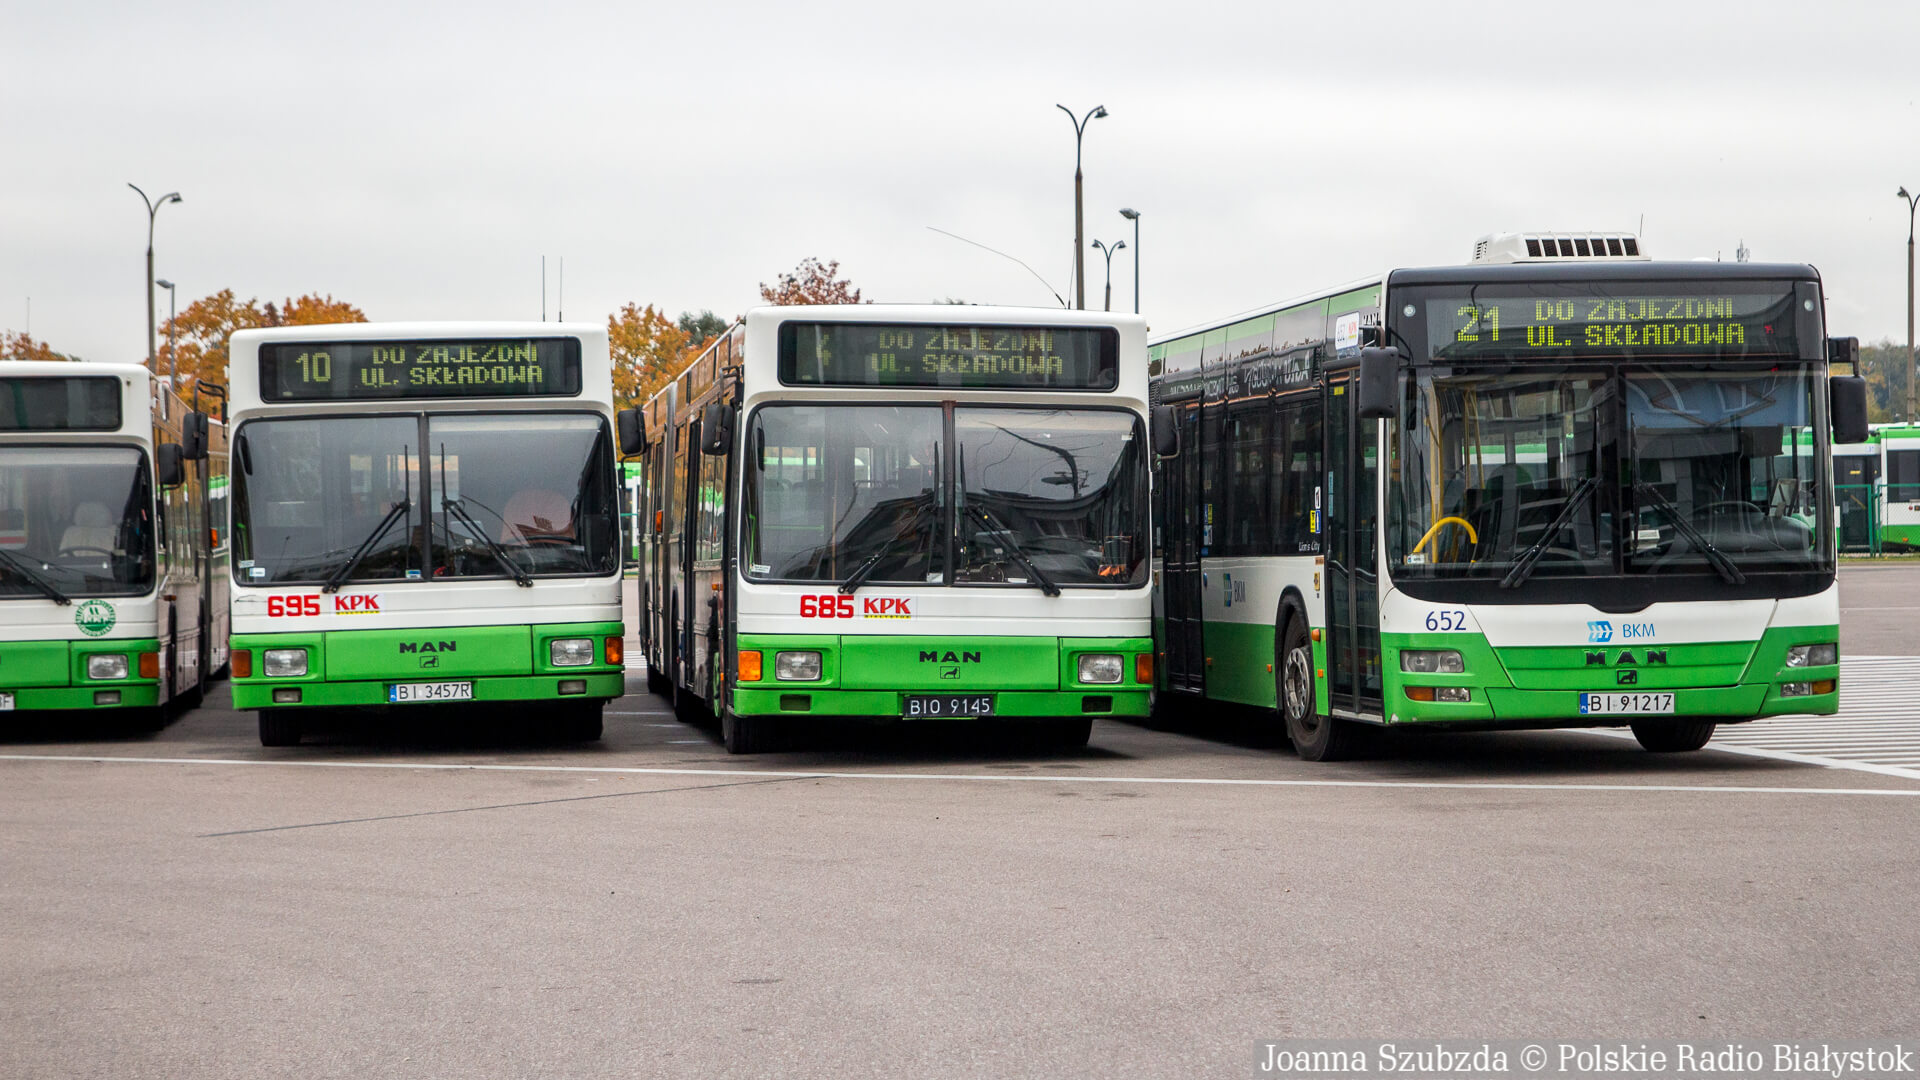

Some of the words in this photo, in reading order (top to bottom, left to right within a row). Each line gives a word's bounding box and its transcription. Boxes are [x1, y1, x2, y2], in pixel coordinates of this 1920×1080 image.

[1535, 299, 1574, 320] DO
[1587, 298, 1733, 320] ZAJEZDNI
[1457, 306, 1499, 341] 21
[879, 332, 913, 350] DO
[1527, 325, 1572, 346] UL.
[1585, 323, 1744, 345] SKŁADOWA
[373, 345, 405, 364] DO
[416, 344, 538, 364] ZAJEZDNI
[296, 352, 331, 383] 10
[872, 353, 911, 373] UL.
[922, 353, 1063, 375] SKŁADOWA
[361, 367, 399, 388] UL.
[410, 366, 543, 386] SKŁADOWA
[267, 594, 321, 618] 695
[335, 594, 380, 611] KPK
[799, 594, 854, 619] 685
[863, 598, 911, 614] KPK
[1425, 610, 1467, 631] 652
[1622, 623, 1656, 638] BKM
[399, 640, 457, 654] MAN
[919, 650, 981, 663] MAN
[1584, 648, 1668, 665] MAN
[399, 685, 417, 700] BI
[425, 683, 470, 699] 3457R
[910, 699, 941, 715] BIO
[951, 697, 990, 713] 9145
[1590, 695, 1611, 712] BI
[1620, 694, 1672, 712] 91217
